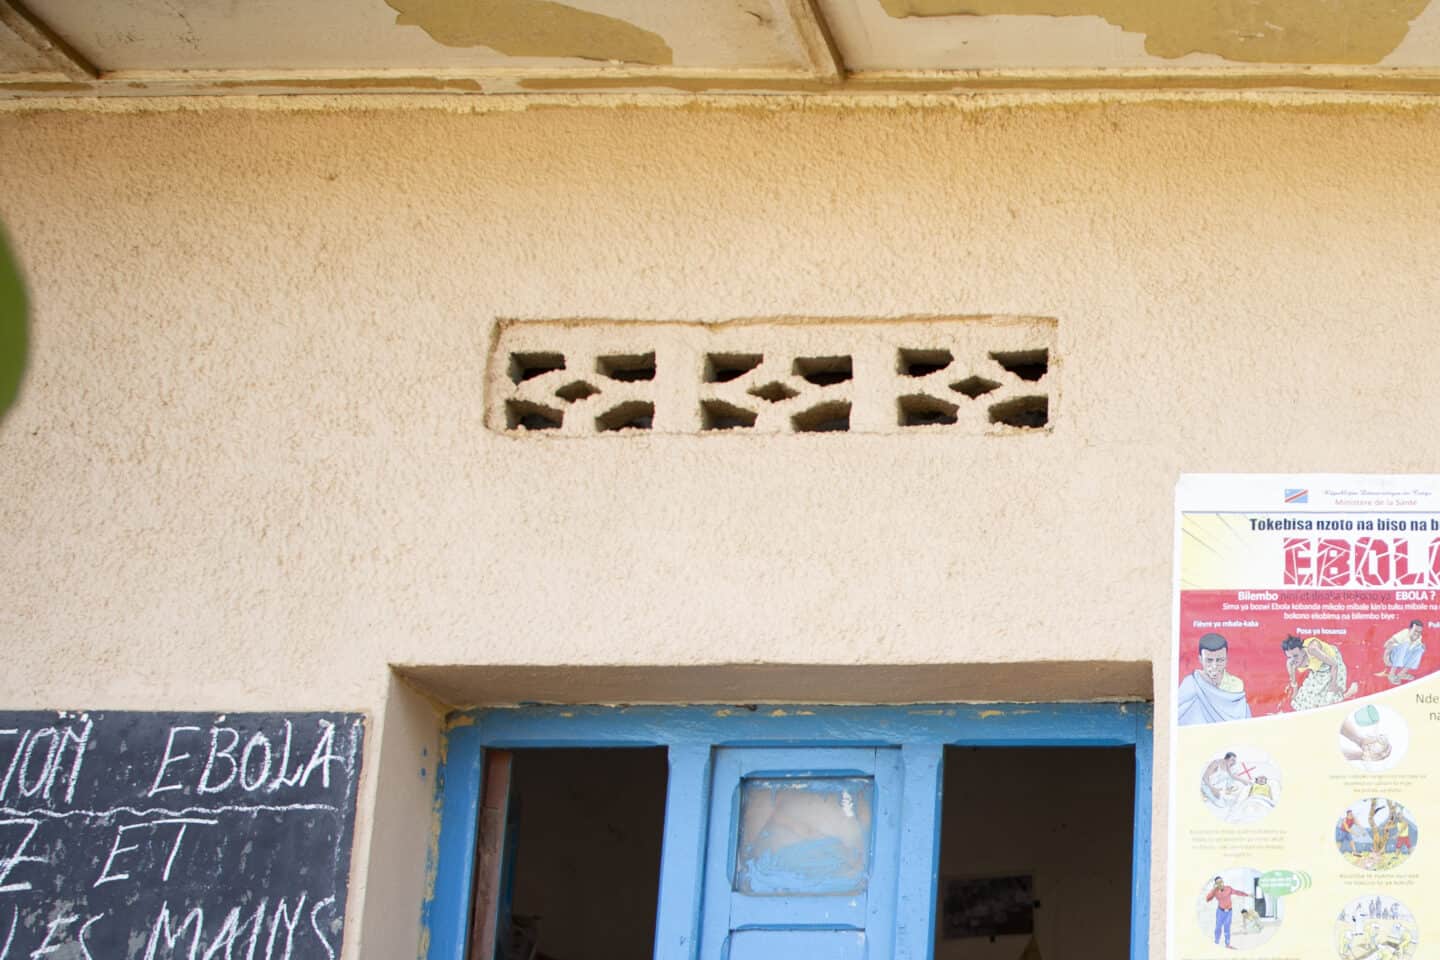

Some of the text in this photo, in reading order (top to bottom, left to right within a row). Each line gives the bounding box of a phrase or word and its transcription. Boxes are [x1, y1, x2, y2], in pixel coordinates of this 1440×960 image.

[1250, 518, 1313, 531] Tokebisa
[1316, 519, 1353, 531] nzoto
[1356, 521, 1373, 531] na
[1377, 519, 1407, 532] biso
[1410, 521, 1427, 532] na
[1238, 591, 1278, 601] Bilembo
[1395, 591, 1428, 601] EBOLA
[1430, 590, 1436, 601] ?
[148, 716, 345, 797] EBOLA
[93, 818, 218, 888] ET
